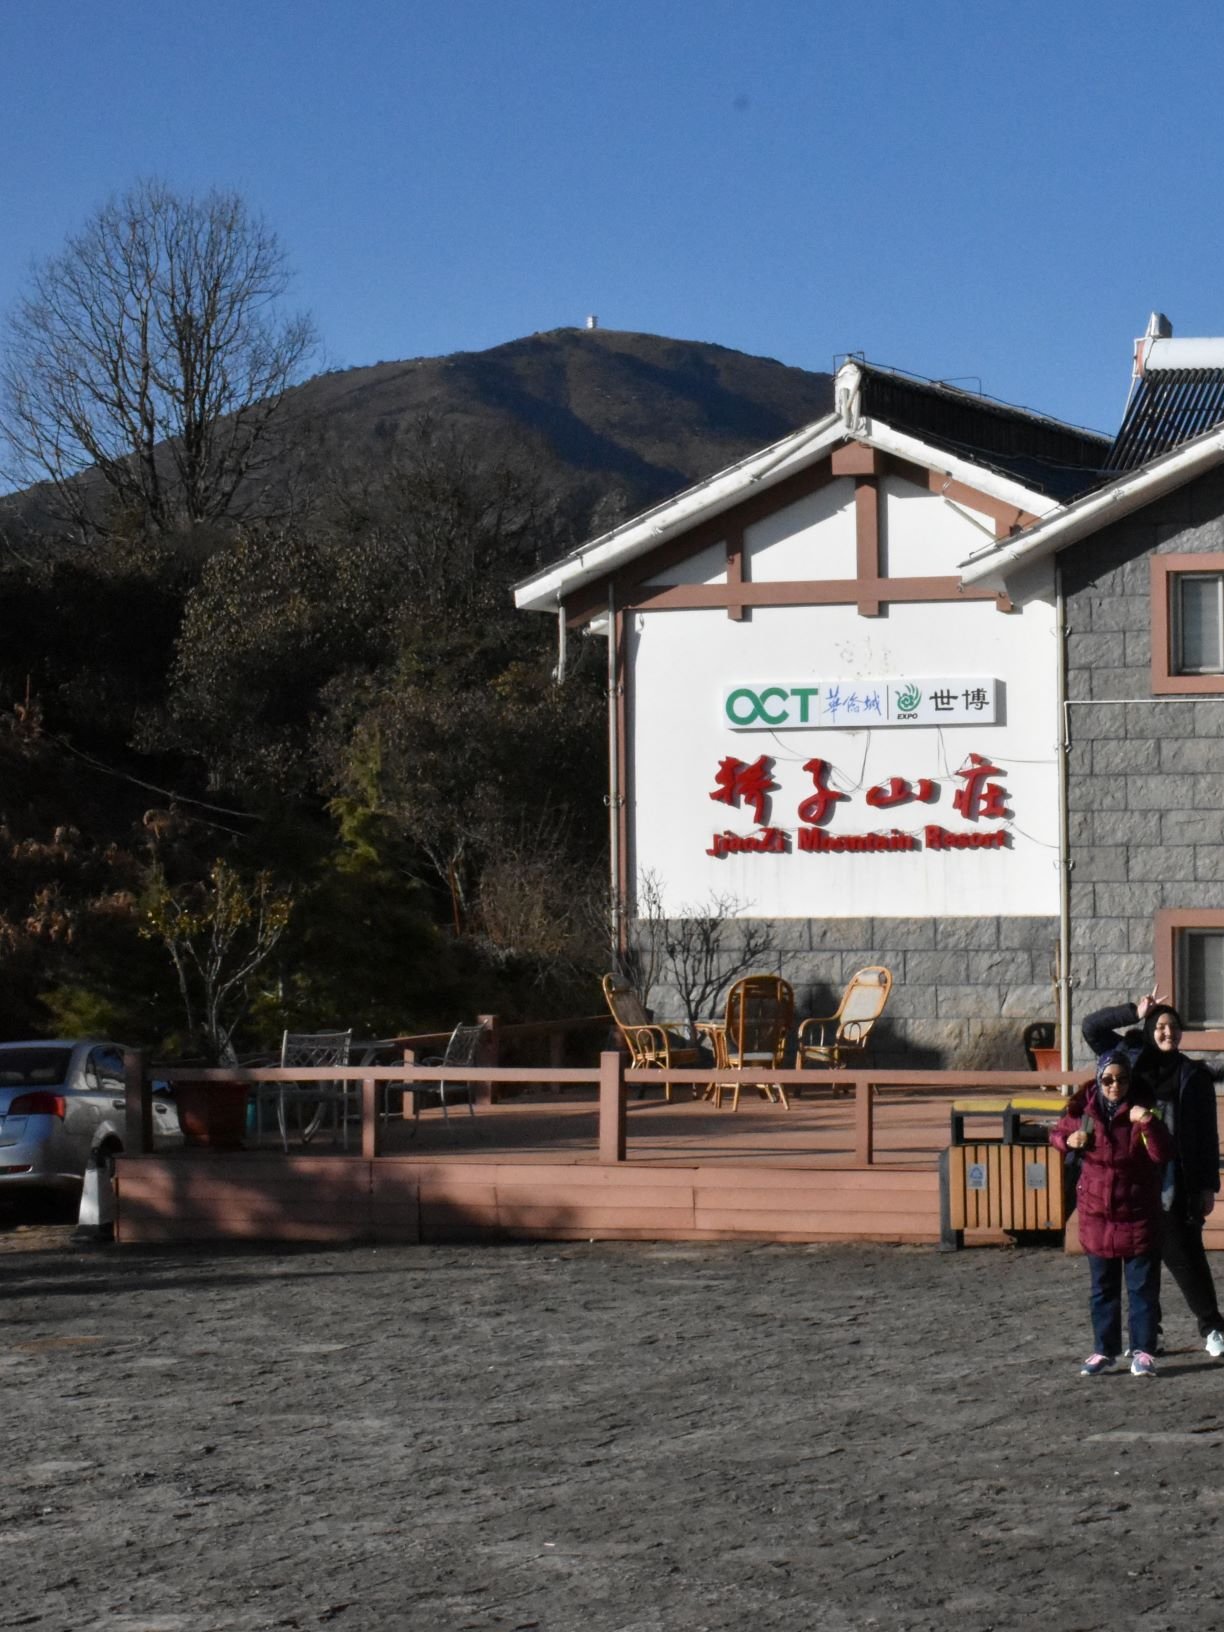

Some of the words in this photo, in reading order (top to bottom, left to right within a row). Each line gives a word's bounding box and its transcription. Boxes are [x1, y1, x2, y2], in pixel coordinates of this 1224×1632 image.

[725, 687, 818, 725] OCT
[929, 688, 990, 712] 世博
[798, 827, 914, 850] Mountain
[925, 825, 1005, 848] Resort
